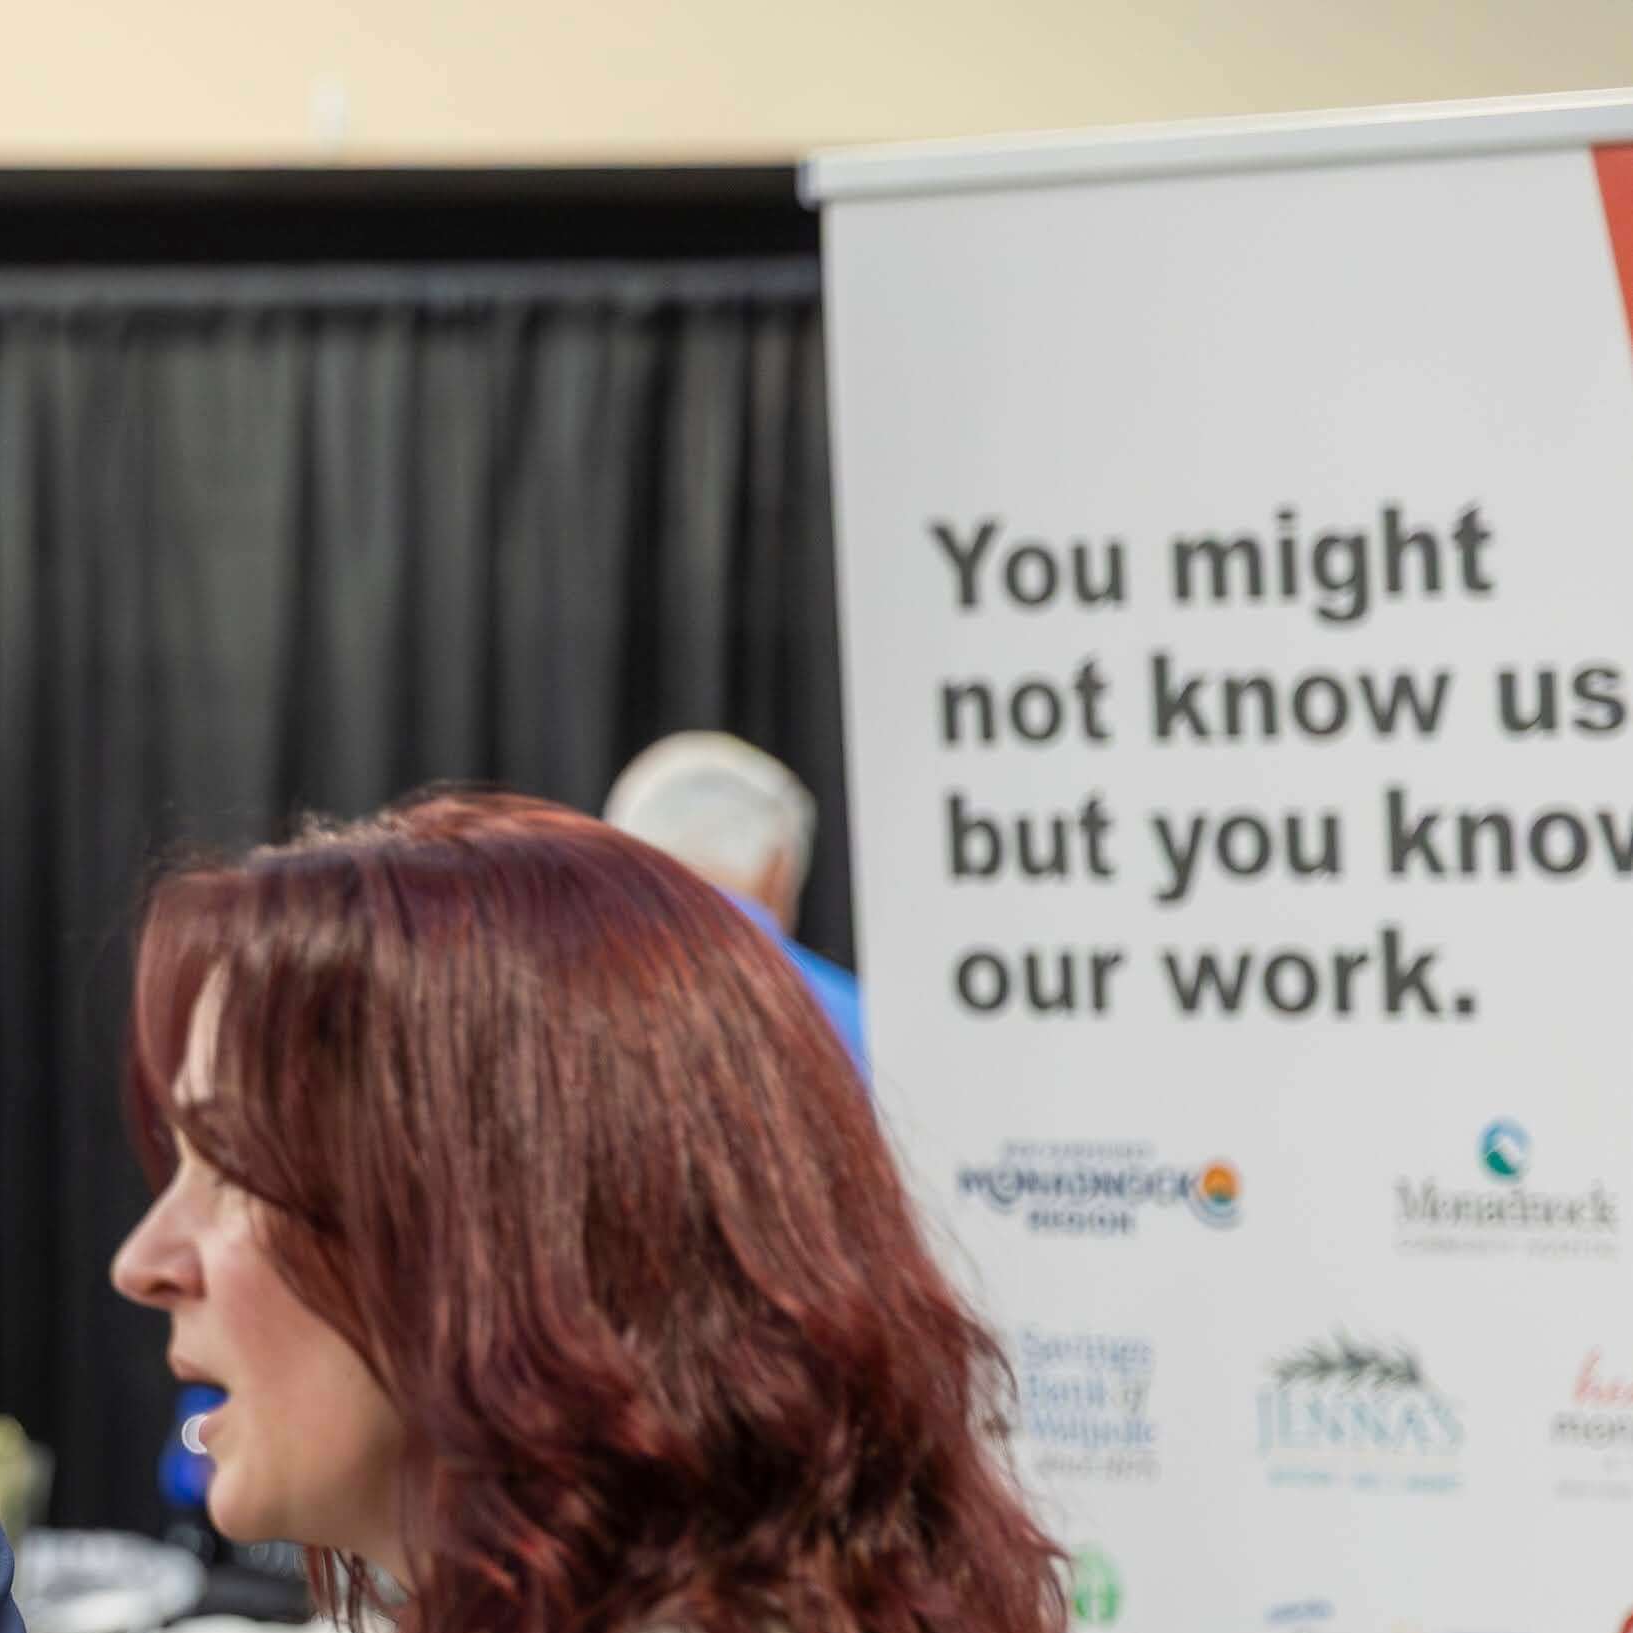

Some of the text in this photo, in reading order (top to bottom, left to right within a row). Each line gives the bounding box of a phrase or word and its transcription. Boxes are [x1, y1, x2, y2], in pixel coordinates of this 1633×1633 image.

[931, 504, 1495, 623] You might
[941, 652, 1627, 748] not know us
[947, 793, 1114, 880] but
[1156, 813, 1339, 906] you
[956, 926, 1476, 1018] our work.
